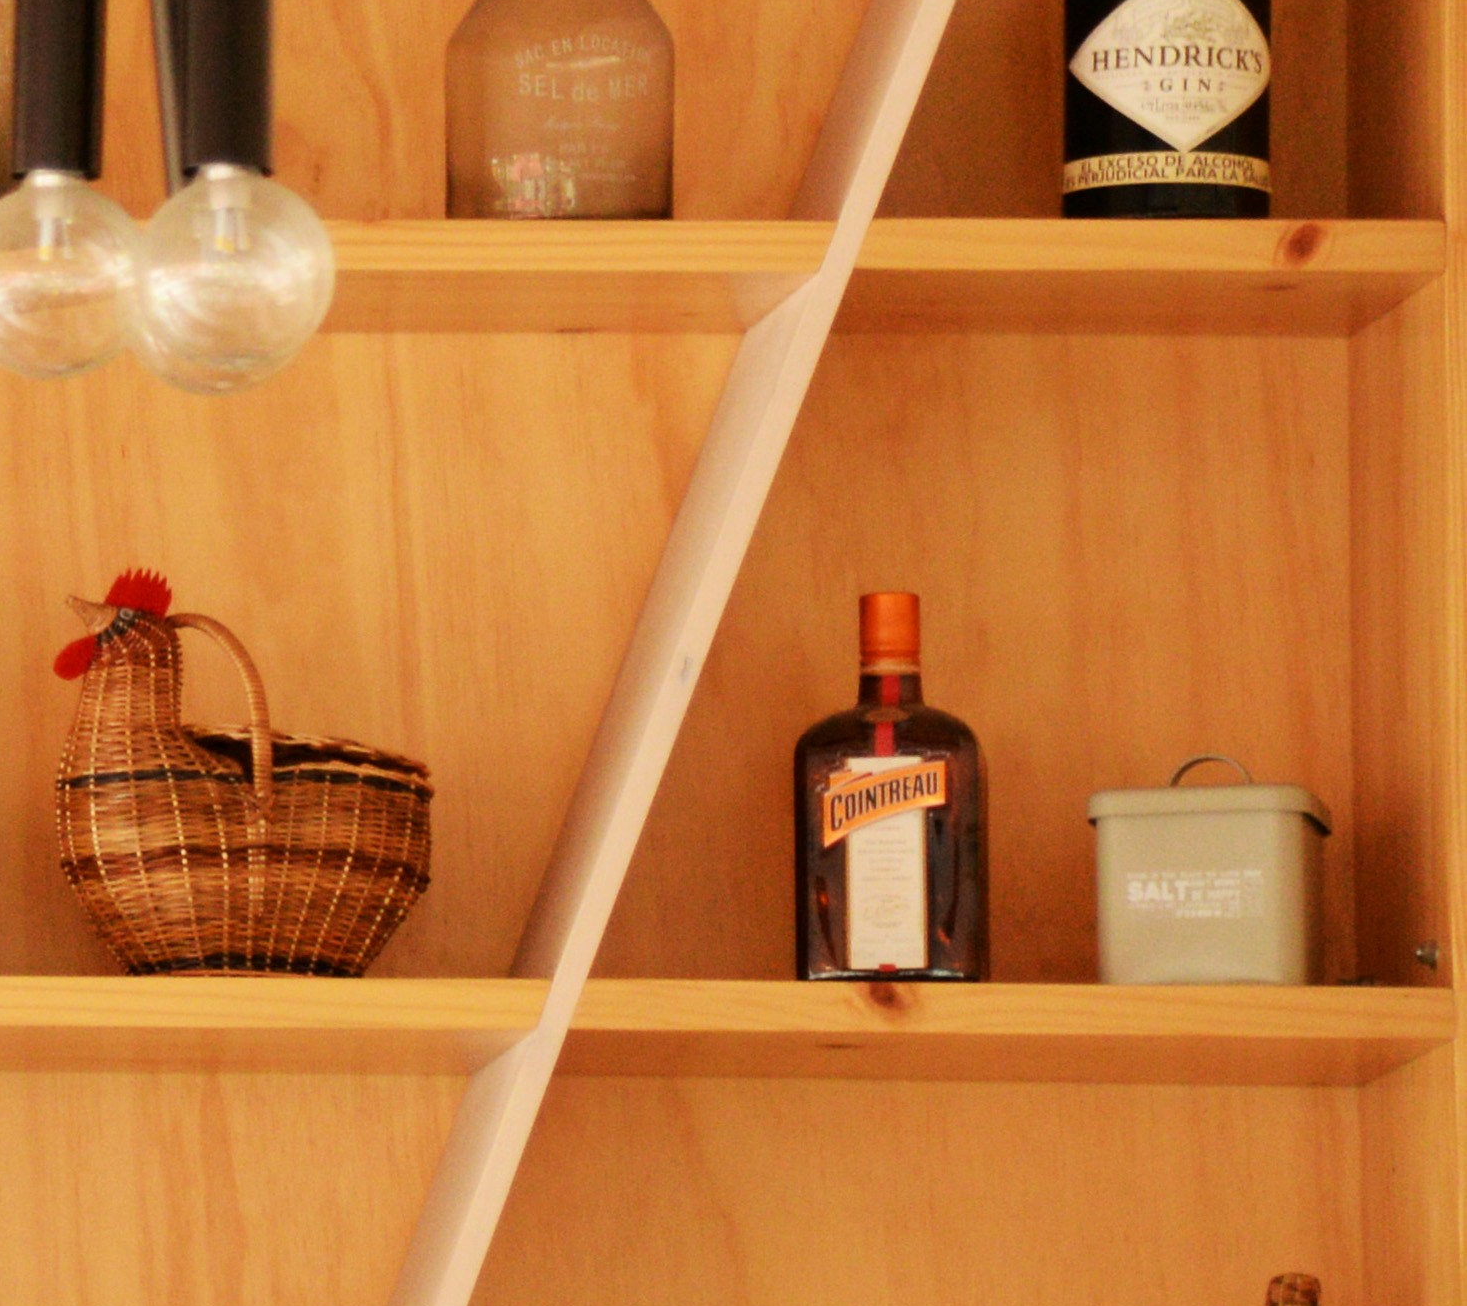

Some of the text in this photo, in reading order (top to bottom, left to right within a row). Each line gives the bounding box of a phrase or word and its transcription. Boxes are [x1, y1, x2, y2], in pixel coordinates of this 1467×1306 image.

[1092, 44, 1264, 75] HENDRICK'S
[519, 70, 649, 103] SEL de MER
[1159, 77, 1213, 93] GIN
[1098, 155, 1158, 171] EXCESO
[1165, 154, 1184, 167] DE
[1189, 155, 1255, 172] ALCOHOL
[1078, 166, 1240, 186] PERJUDICIAL PARA LA
[830, 769, 939, 832] COINTREAU
[1127, 880, 1190, 902] SALT
